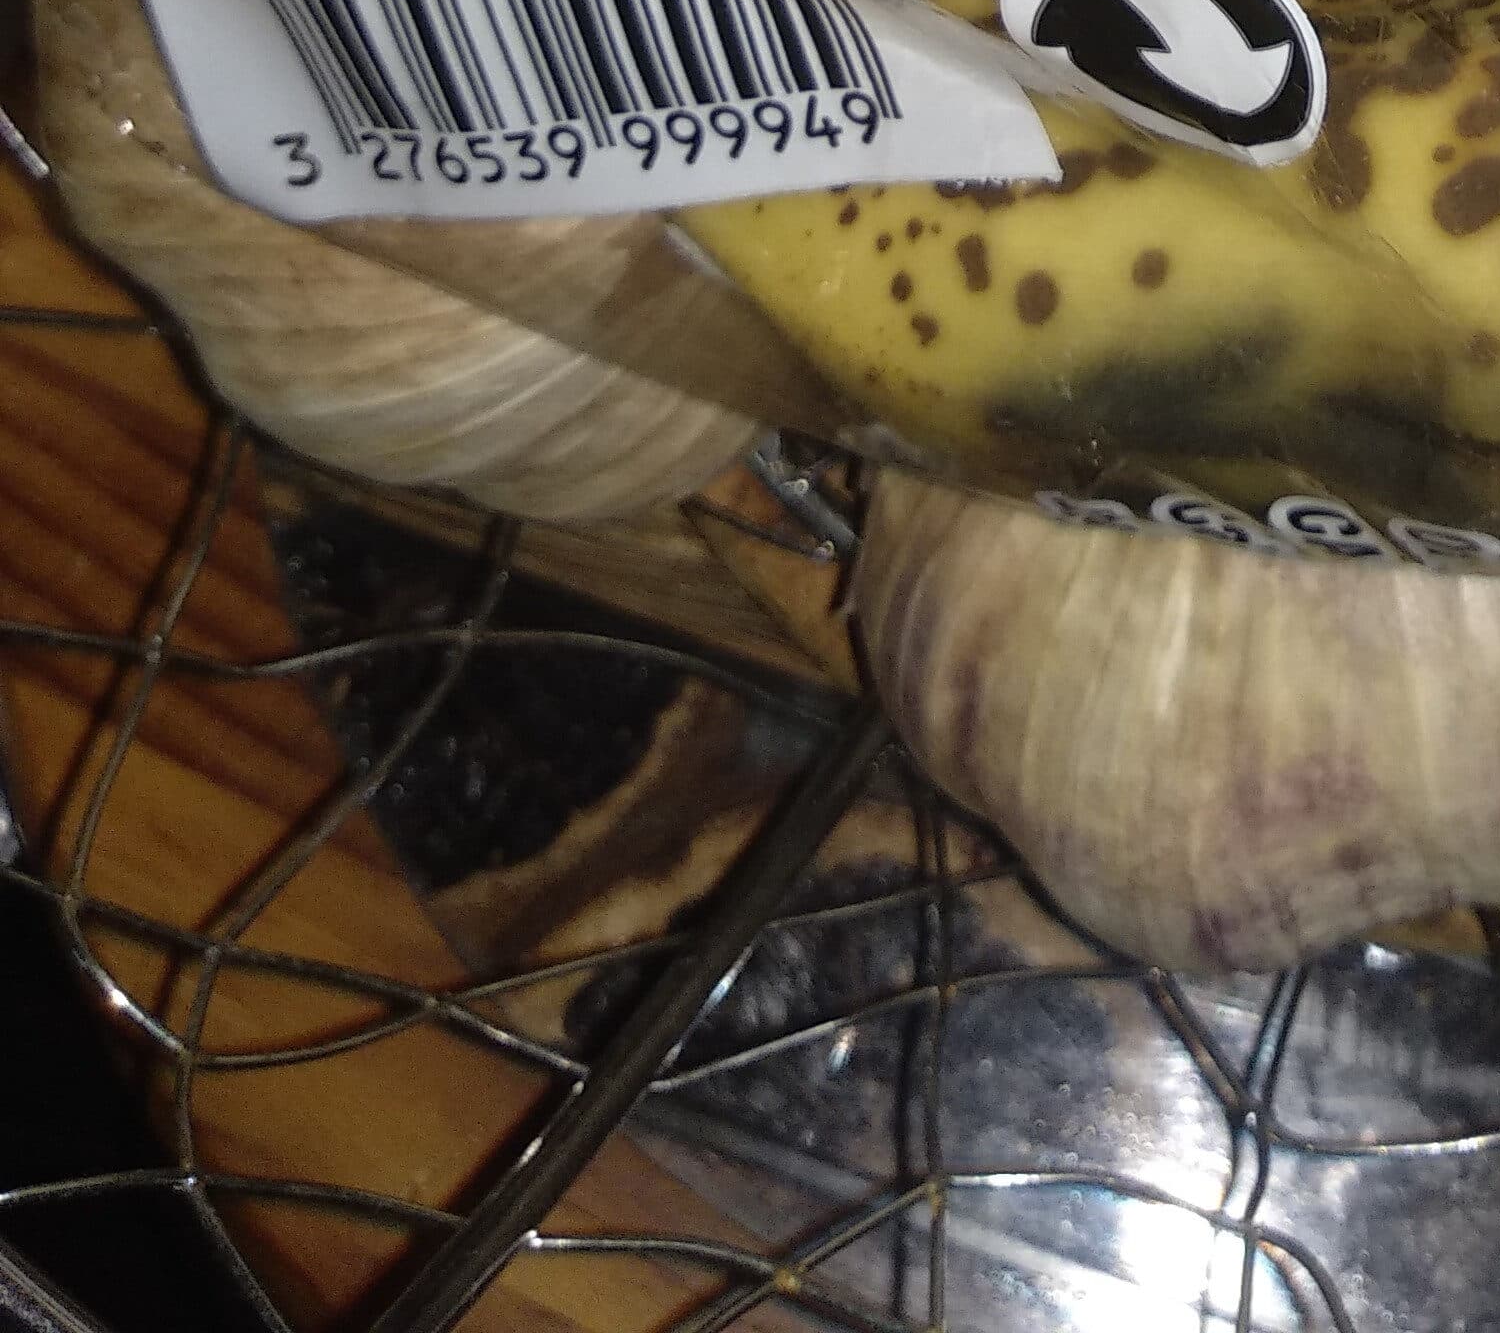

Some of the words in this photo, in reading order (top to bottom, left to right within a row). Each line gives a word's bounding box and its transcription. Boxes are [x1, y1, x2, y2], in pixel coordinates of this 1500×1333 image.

[273, 133, 322, 186] 3
[361, 123, 587, 185] 276539
[621, 89, 880, 171] 999949
